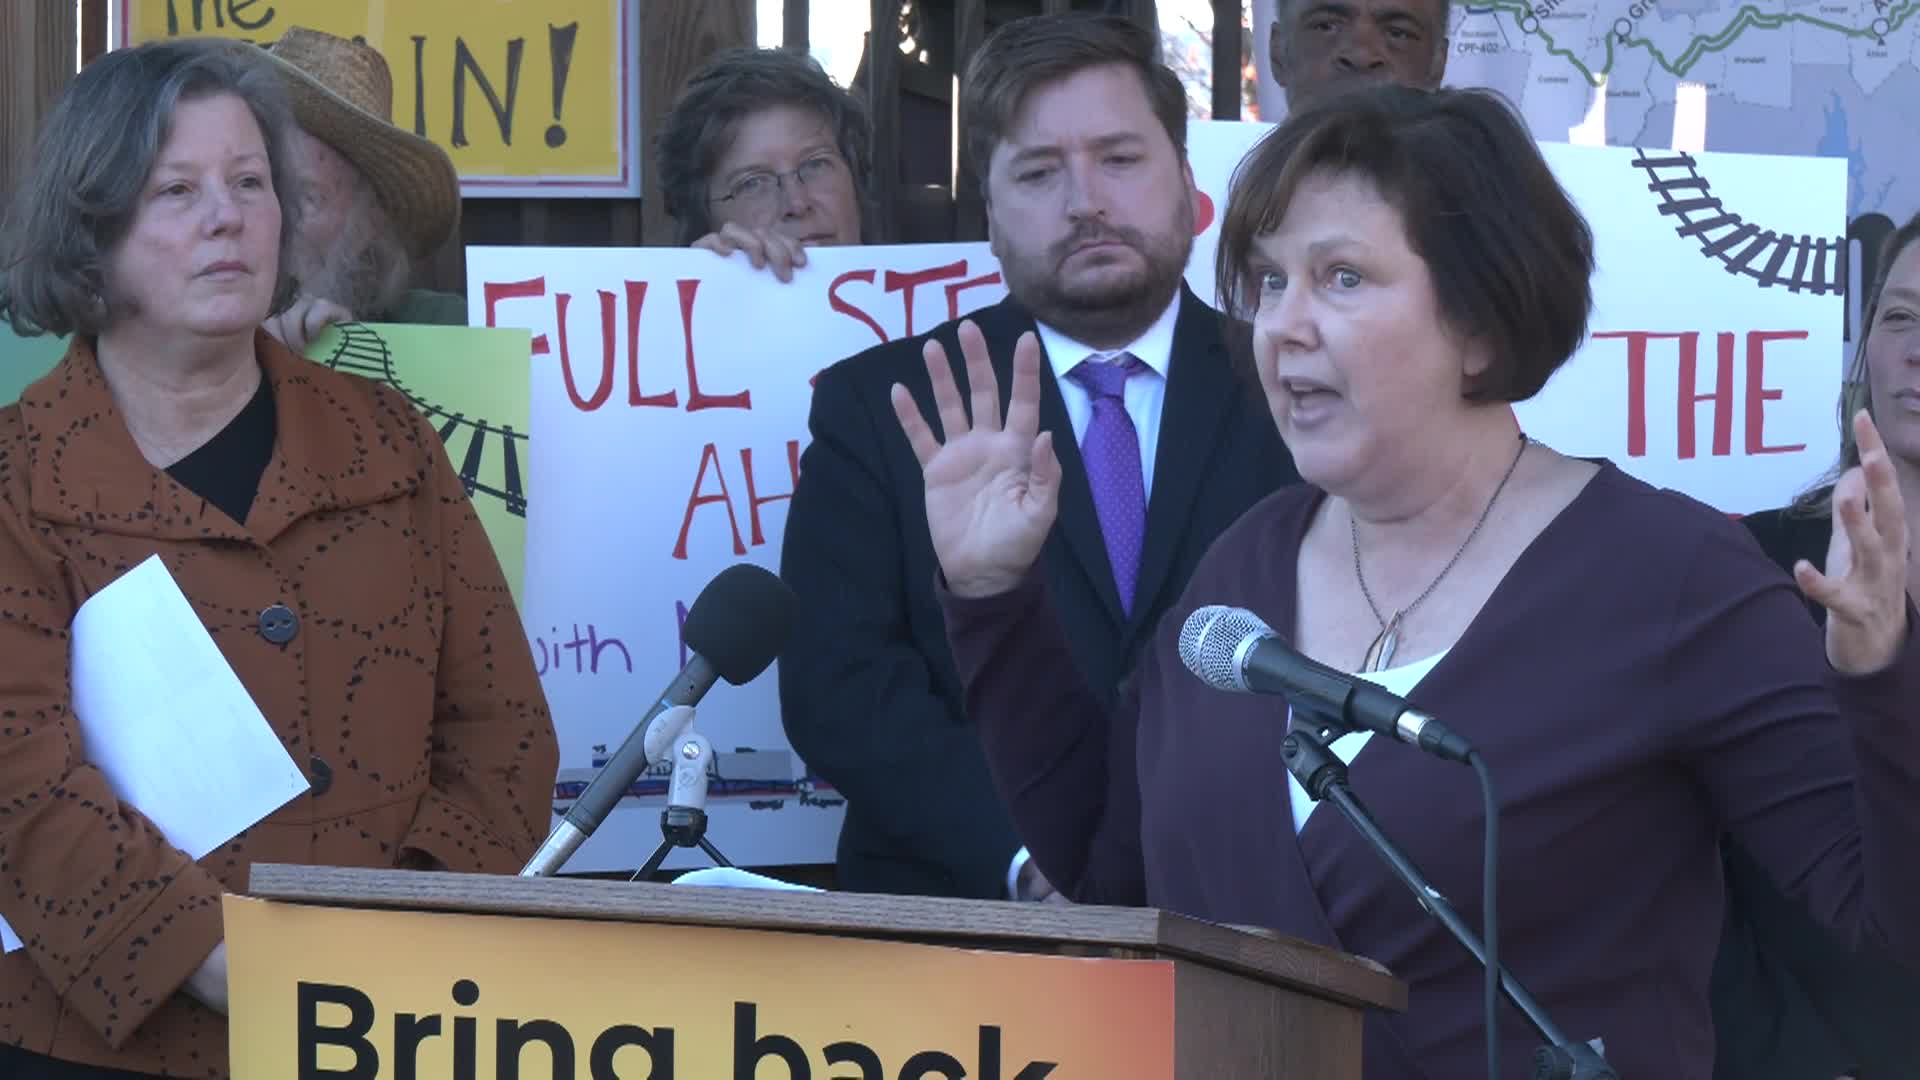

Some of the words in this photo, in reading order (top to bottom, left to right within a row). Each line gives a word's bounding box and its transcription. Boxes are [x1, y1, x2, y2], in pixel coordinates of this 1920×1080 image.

[484, 276, 752, 412] FULL
[1591, 329, 1809, 460] THE
[296, 978, 675, 1080] Bring
